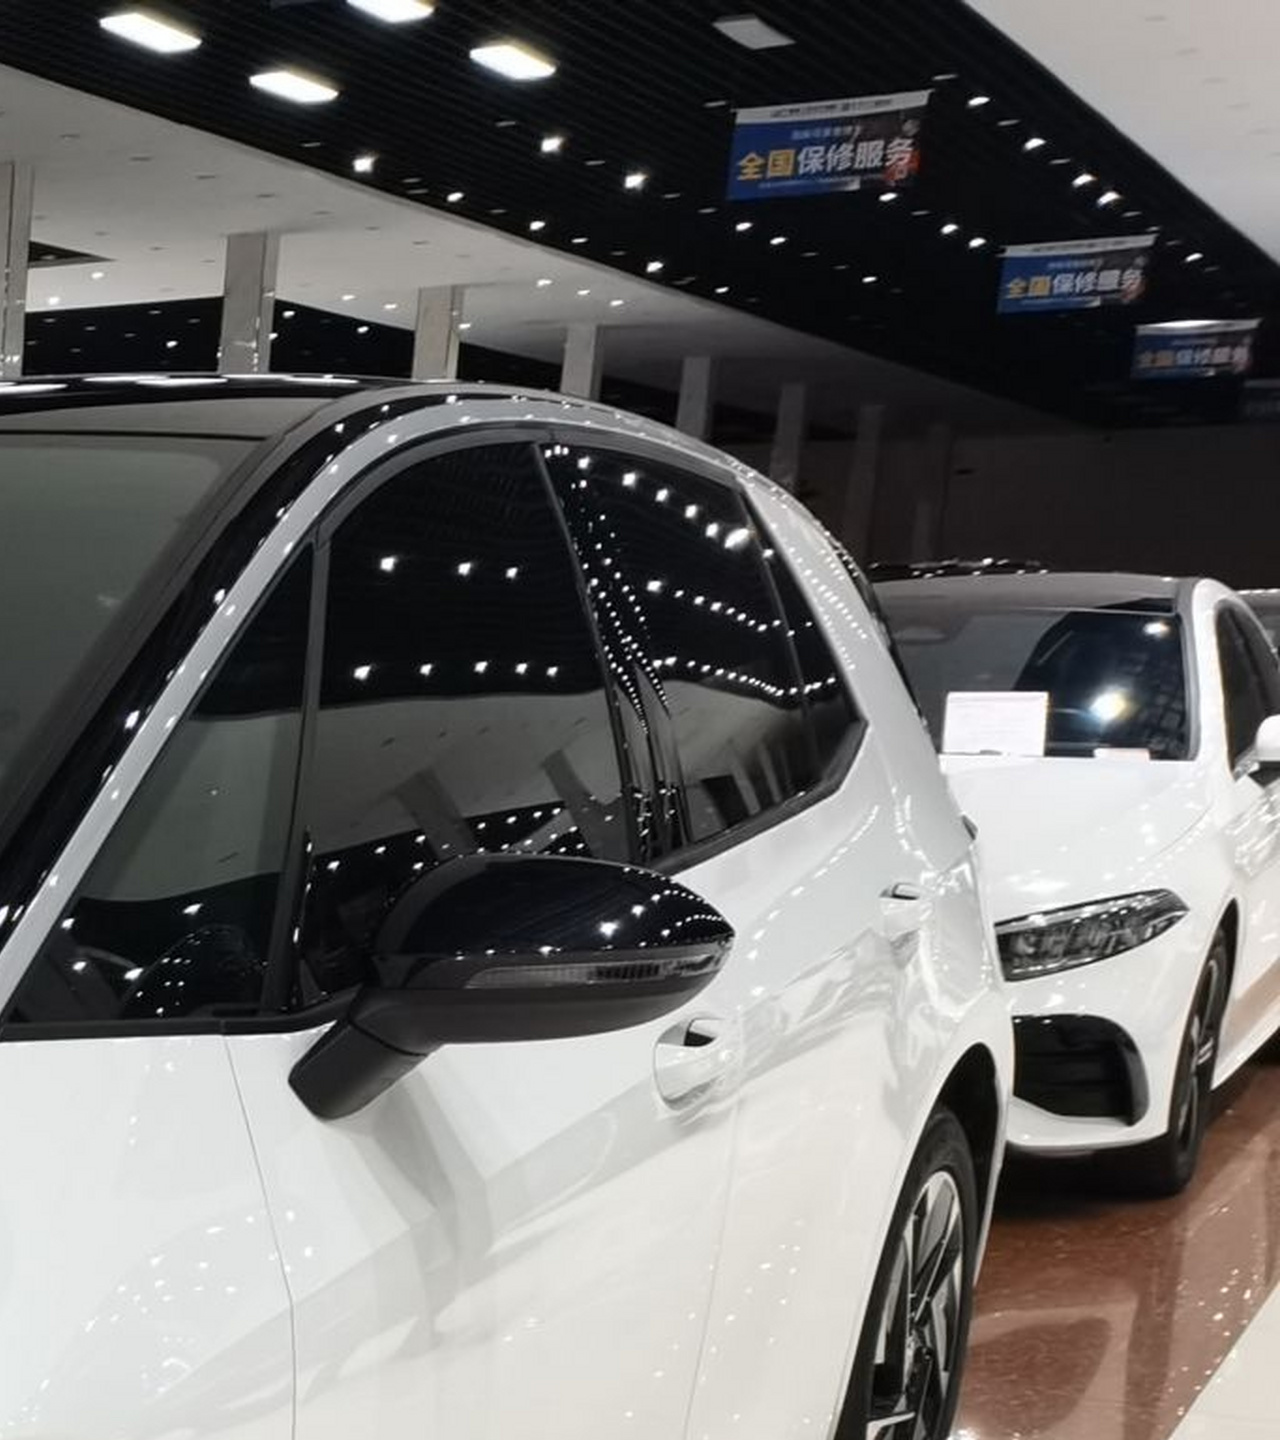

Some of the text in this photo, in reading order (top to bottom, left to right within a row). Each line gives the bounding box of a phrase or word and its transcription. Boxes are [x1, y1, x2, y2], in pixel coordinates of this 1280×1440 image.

[737, 137, 914, 180] 全国保修服务
